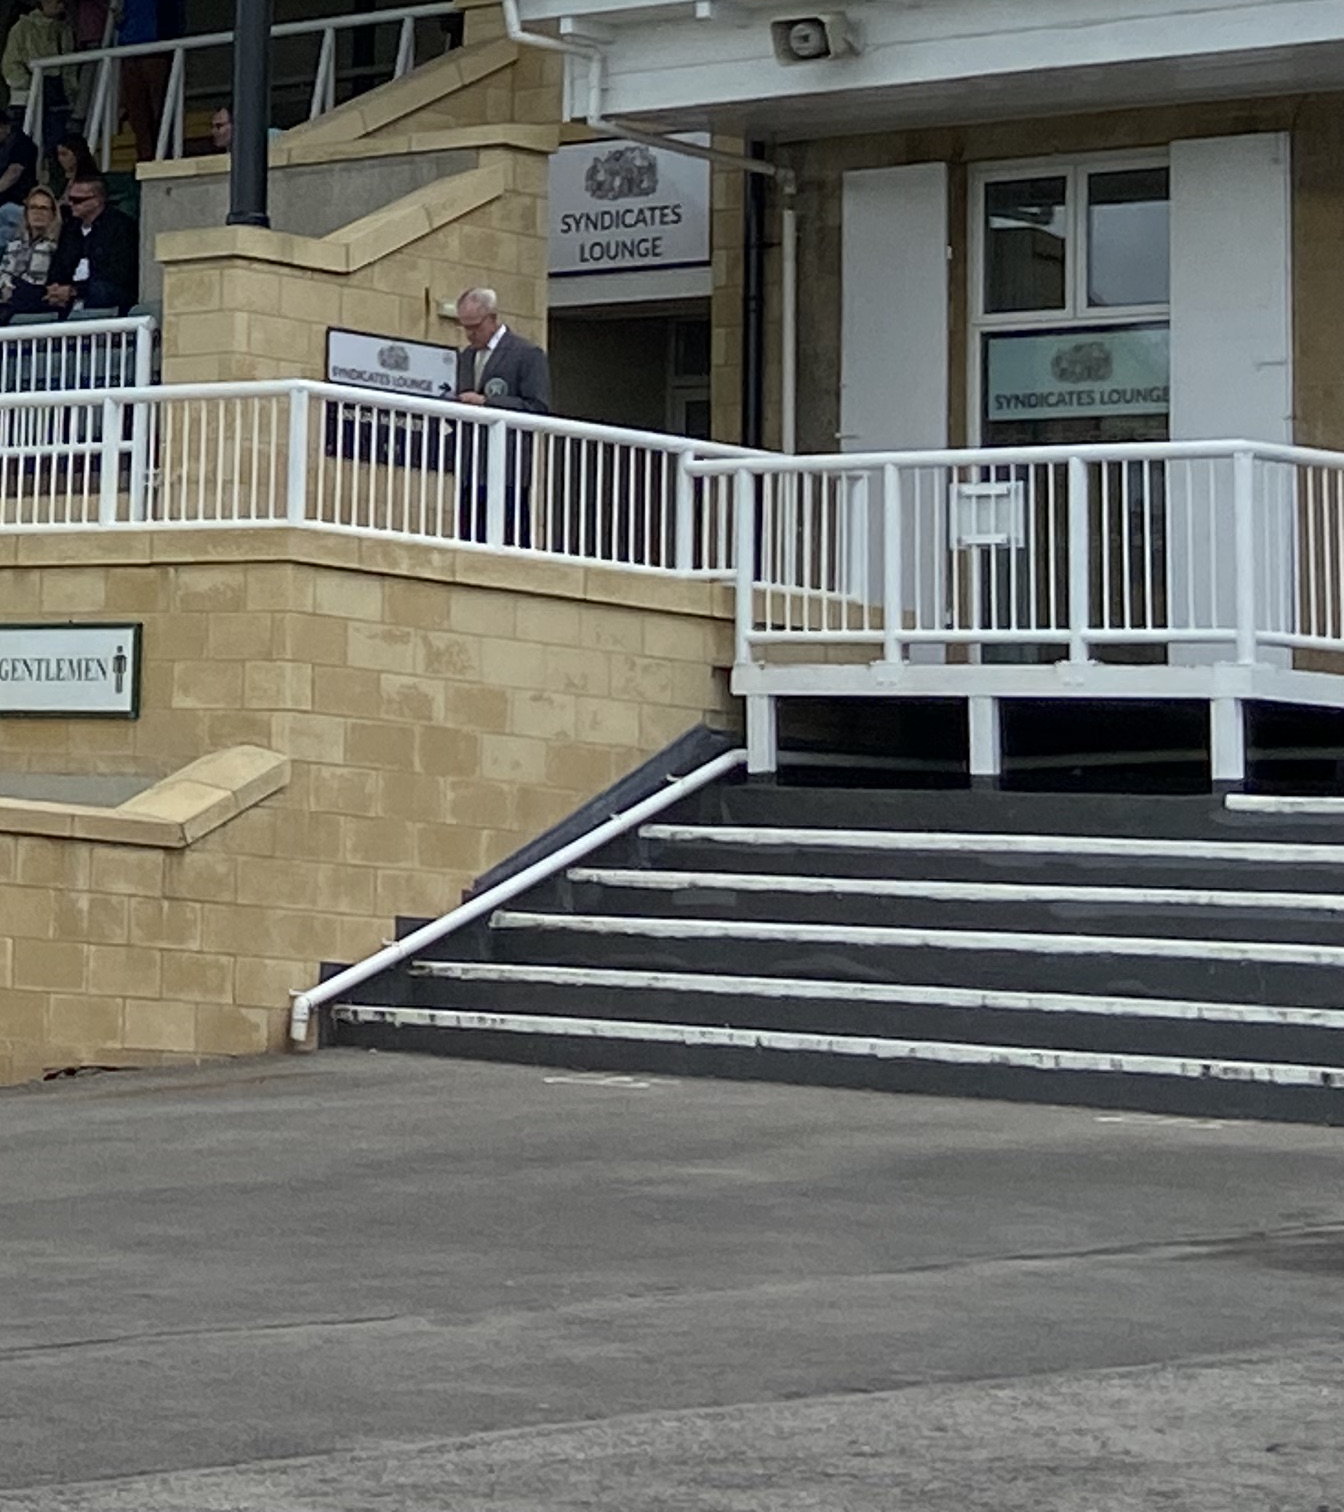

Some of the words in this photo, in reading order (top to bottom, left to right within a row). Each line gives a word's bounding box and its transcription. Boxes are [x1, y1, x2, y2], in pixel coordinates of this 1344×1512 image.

[560, 203, 682, 234] SYNDICATES
[579, 237, 663, 263] LOUNGE
[994, 390, 1096, 410] SYNDICATES
[1100, 386, 1170, 405] LOUNGE
